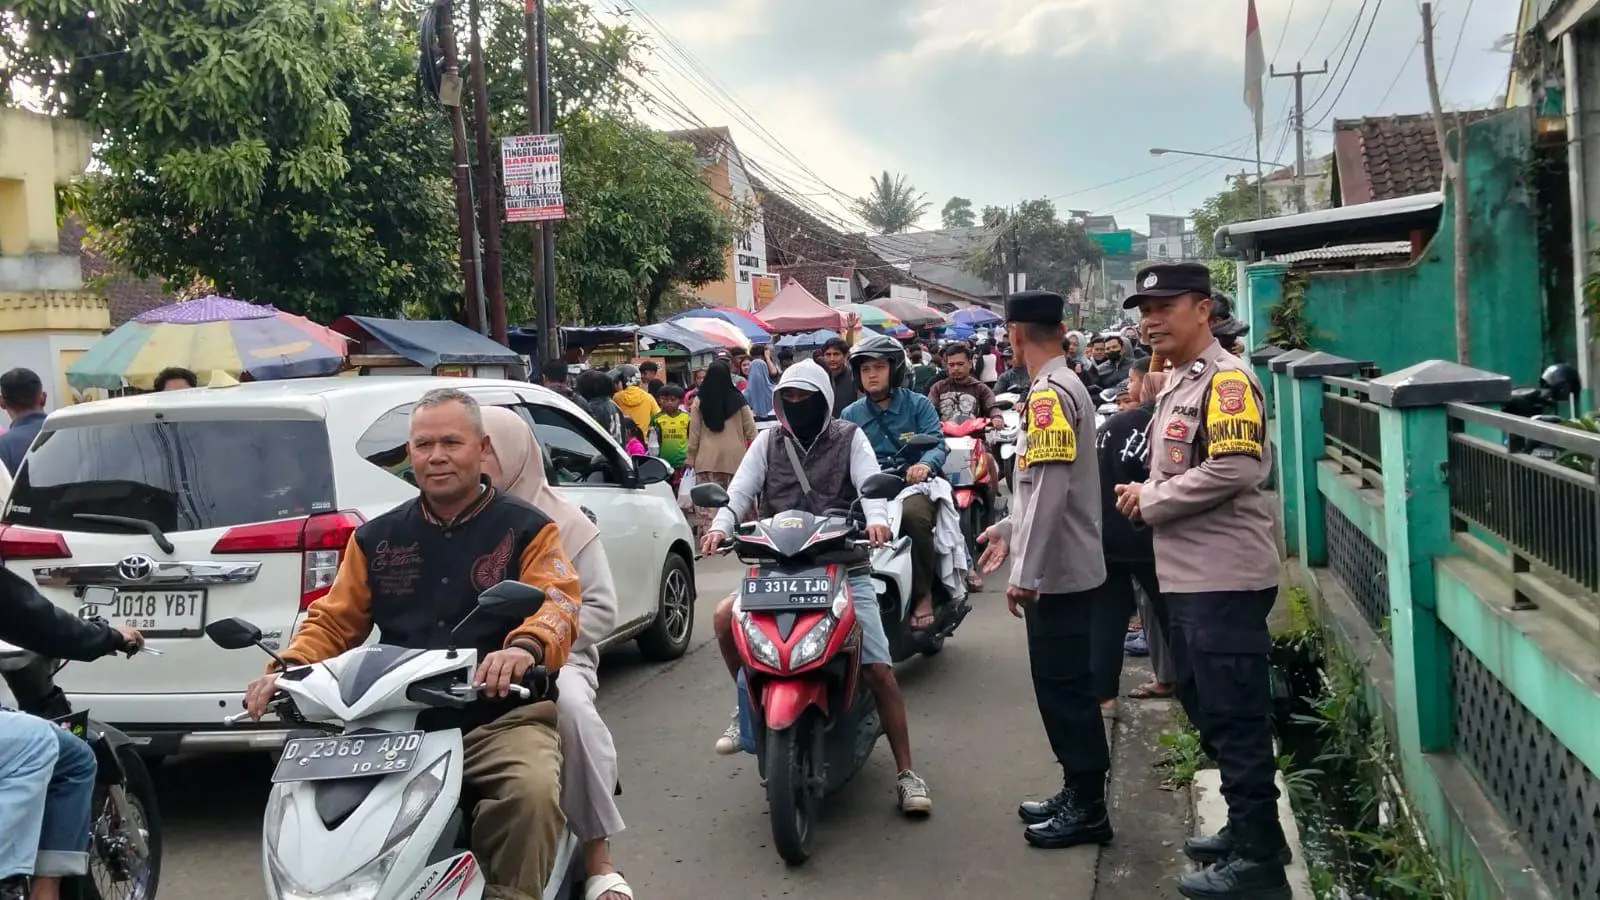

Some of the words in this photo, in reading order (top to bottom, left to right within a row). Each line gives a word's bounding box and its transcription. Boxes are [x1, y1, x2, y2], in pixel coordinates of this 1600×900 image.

[504, 148, 531, 158] TINGGI
[532, 146, 559, 156] BADAN
[504, 156, 558, 165] BANDUNG
[1171, 405, 1198, 418] POLRI
[748, 582, 757, 593] B
[765, 580, 798, 593] 3314
[804, 580, 828, 592] TJO
[111, 594, 156, 617] 1018
[165, 594, 198, 617] YBT
[284, 743, 299, 760] D
[308, 739, 365, 759] 2368
[410, 870, 439, 900] ONDA
